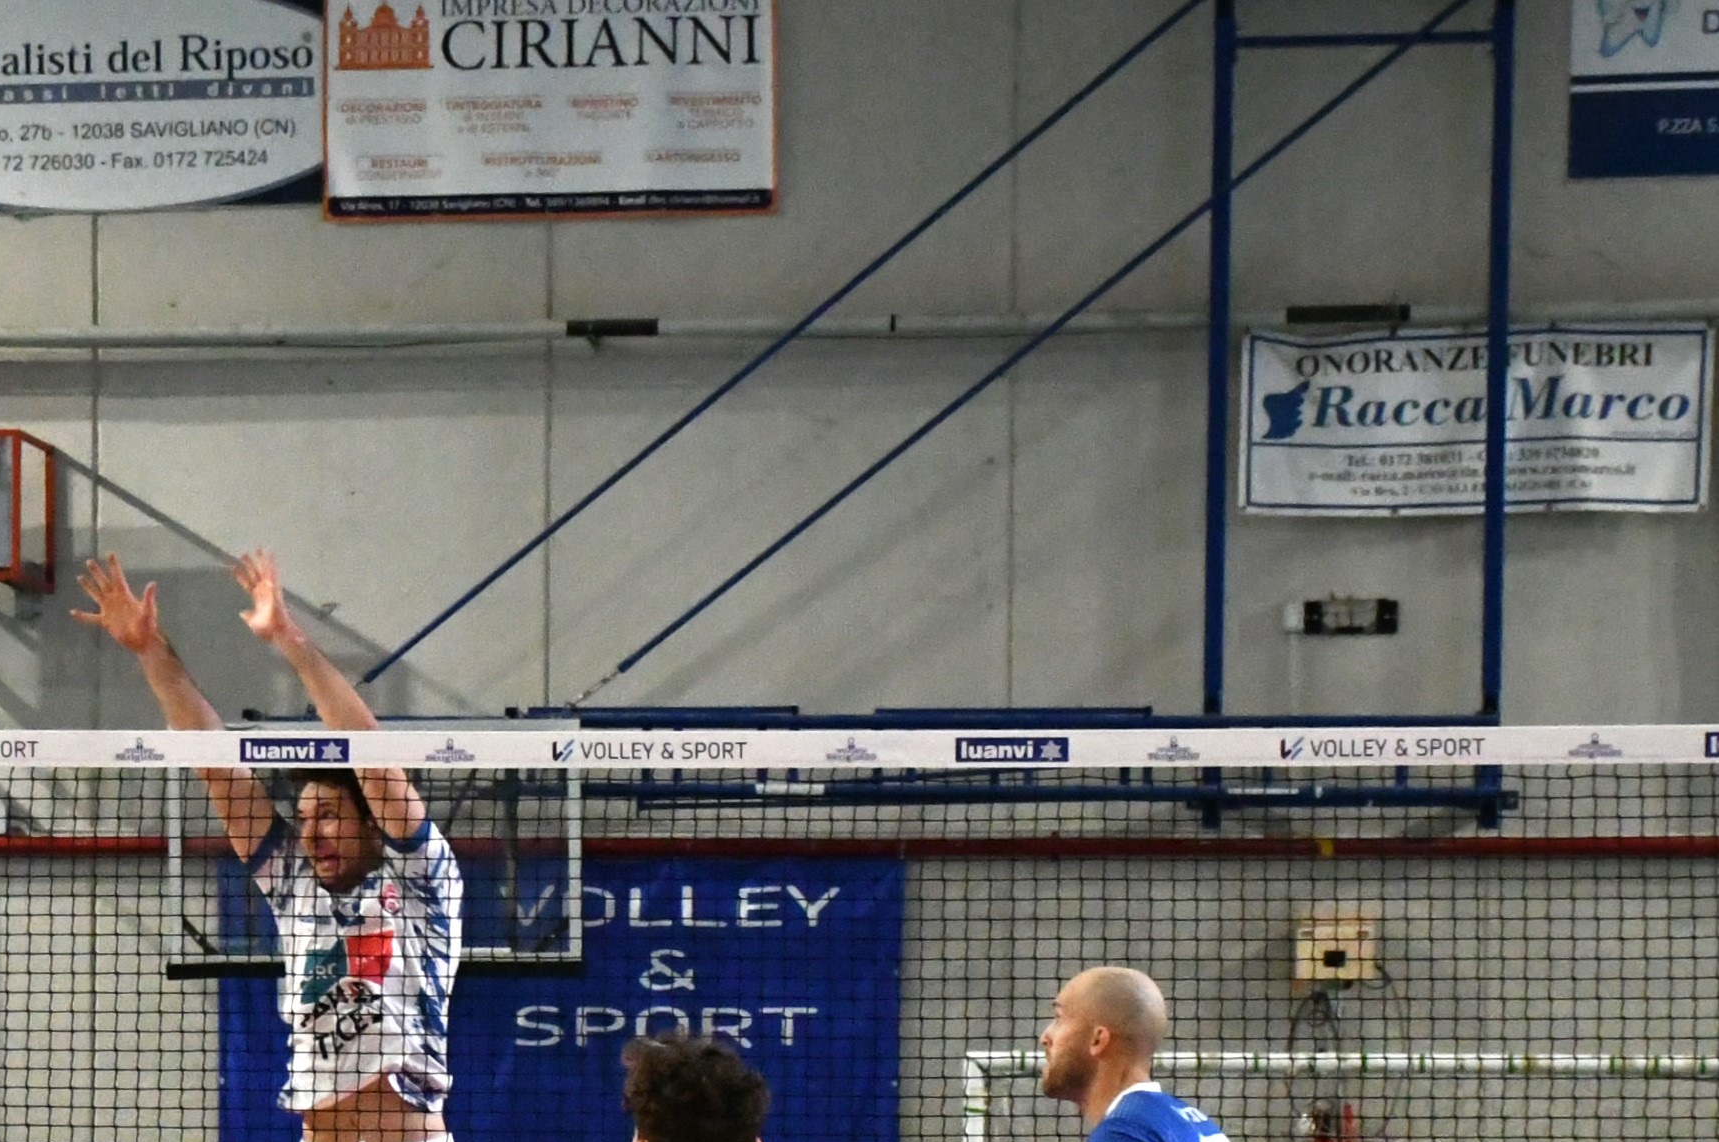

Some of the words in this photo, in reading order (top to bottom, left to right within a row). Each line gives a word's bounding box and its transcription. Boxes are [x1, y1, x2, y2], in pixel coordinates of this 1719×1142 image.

[107, 40, 162, 73] del
[179, 33, 313, 81] Riposo
[441, 15, 761, 70] CIRIANNI
[100, 82, 175, 100] letti
[206, 78, 310, 98] divani
[20, 125, 53, 142] 27b
[72, 123, 125, 141] 12038
[130, 120, 248, 139] SAVIGLIANO
[254, 119, 298, 140] (CN)
[29, 153, 95, 171] 726030
[111, 152, 148, 169] Fax.
[154, 151, 197, 169] 0172
[203, 150, 269, 168] 725424
[1295, 342, 1488, 378] ONORANZE
[1312, 385, 1488, 428] Racca
[1505, 373, 1691, 422] Marco
[244, 739, 317, 760] luanvi
[580, 741, 655, 760] VOLLEY
[660, 741, 675, 760] &
[681, 741, 747, 760] SPORT
[959, 739, 1034, 760] luanvi
[1310, 738, 1388, 758] VOLLEY
[1395, 738, 1409, 757] &
[1415, 737, 1485, 757] SPORT
[502, 885, 841, 928] VOLLEY
[638, 948, 695, 991] &
[514, 1005, 818, 1049] SPORT
